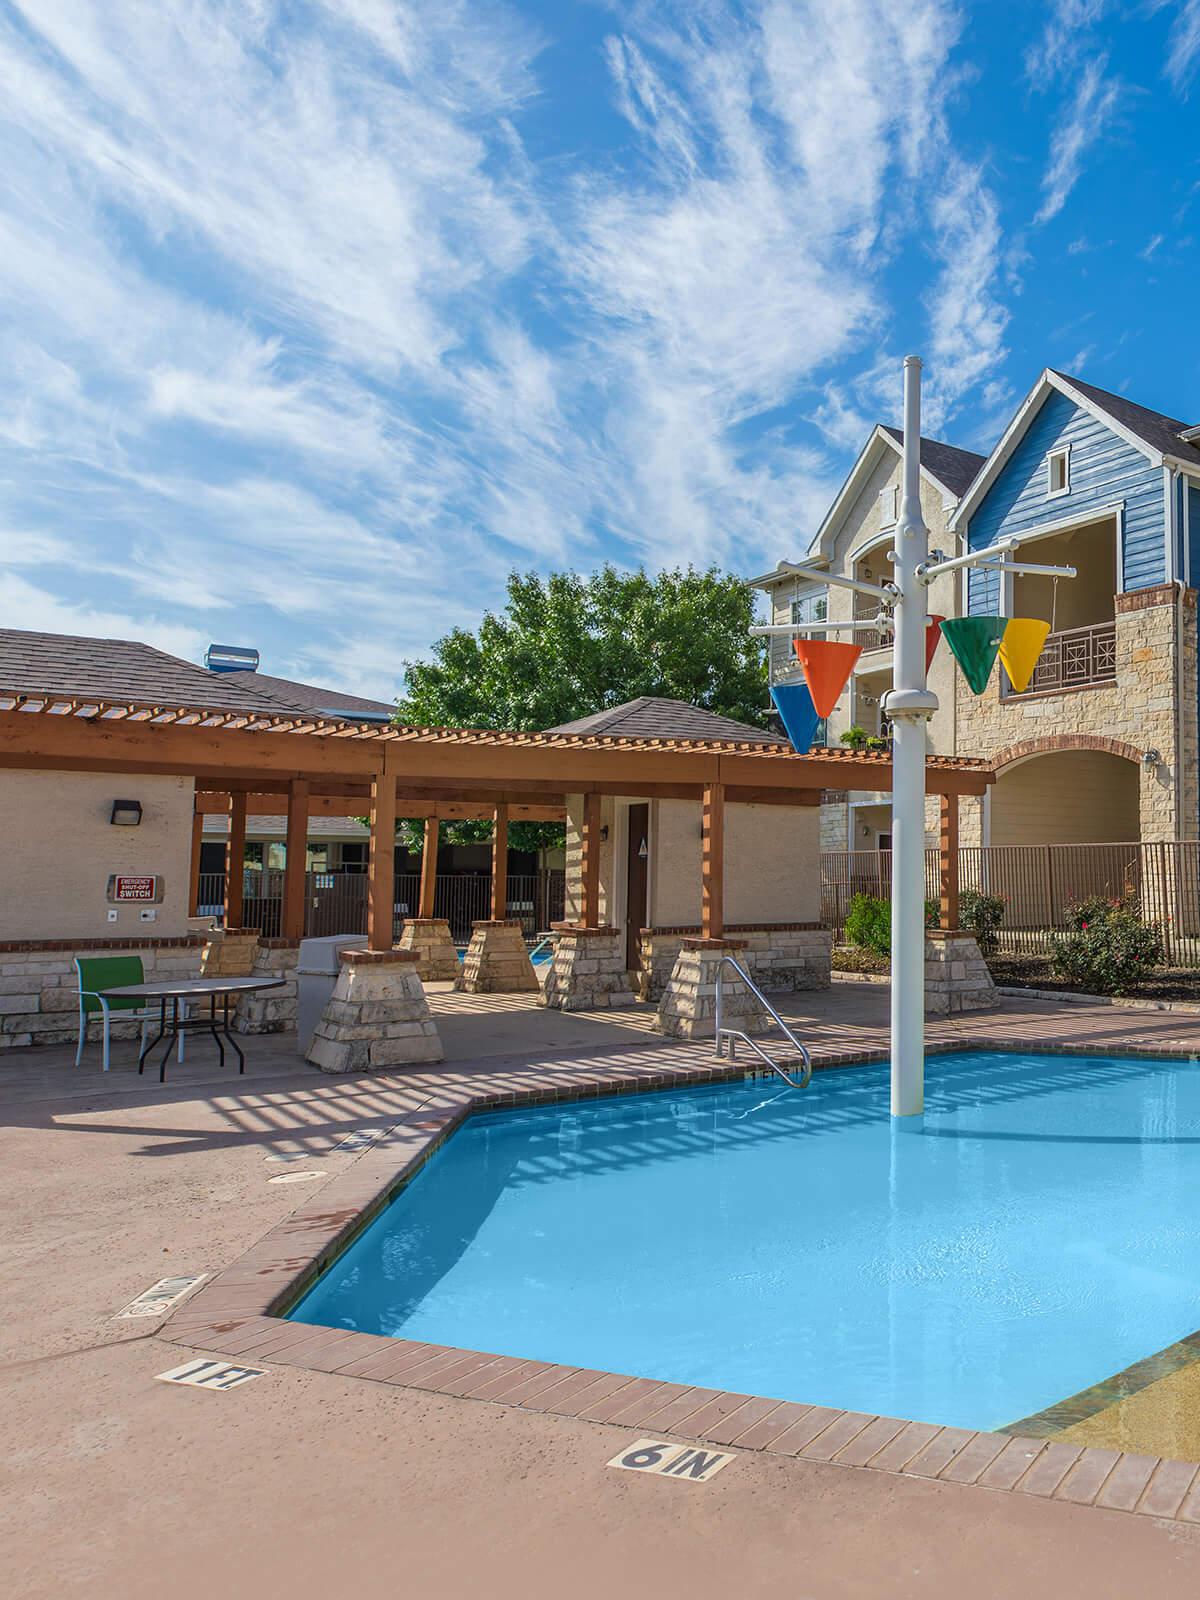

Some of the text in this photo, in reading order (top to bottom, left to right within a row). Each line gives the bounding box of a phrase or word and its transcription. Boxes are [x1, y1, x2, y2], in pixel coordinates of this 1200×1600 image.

[119, 889, 151, 897] SWITCH
[173, 1361, 218, 1380] 1
[621, 1444, 673, 1469] 6
